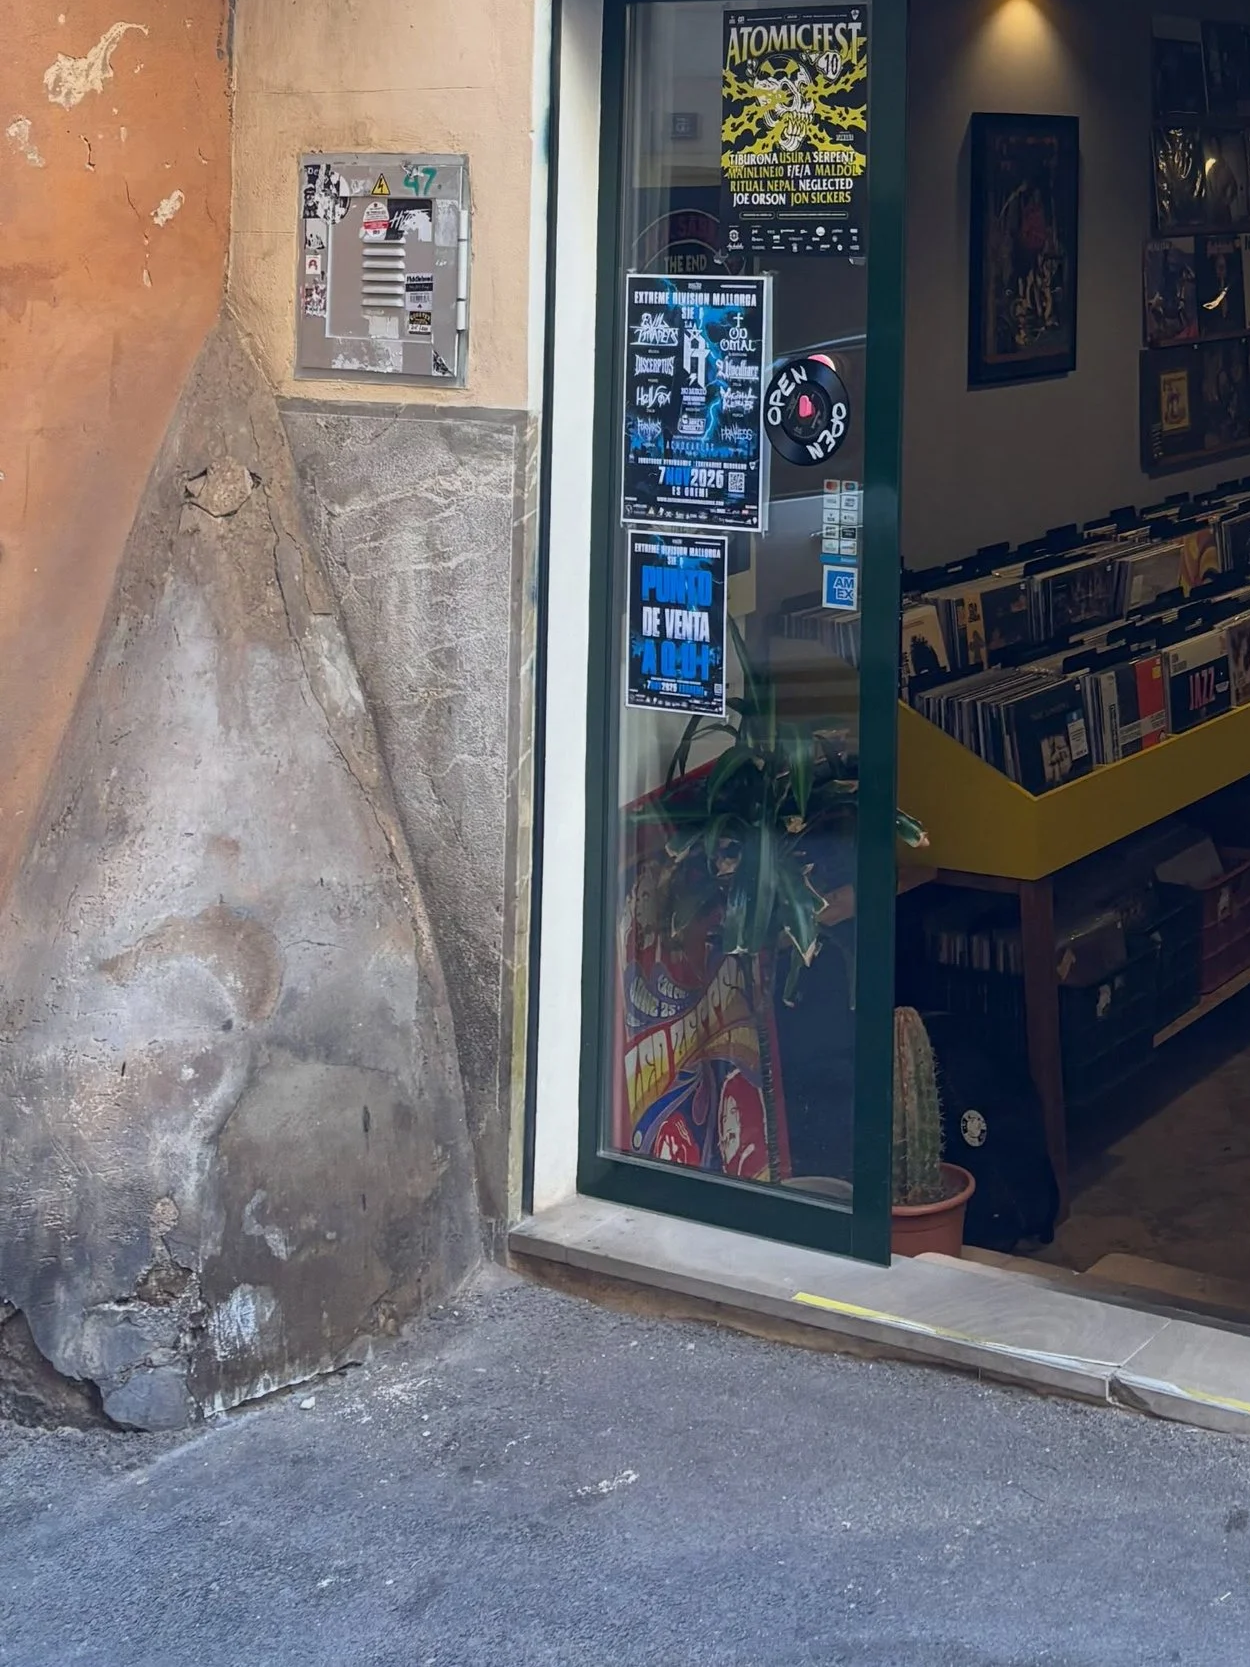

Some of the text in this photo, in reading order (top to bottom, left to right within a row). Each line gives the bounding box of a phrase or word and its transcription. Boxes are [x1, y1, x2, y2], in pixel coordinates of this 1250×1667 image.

[726, 22, 862, 71] ATOMICFEST
[779, 152, 811, 165] USURA
[812, 150, 855, 164] SERPENT
[730, 178, 853, 193] RITUAL NEPAL NEGLECTED
[733, 191, 851, 206] JOE ORSON JON SICKERS
[768, 365, 808, 426] OPEN
[807, 402, 847, 461] OPEN
[641, 565, 713, 607] PUNTO
[833, 577, 855, 589] AM
[836, 588, 855, 602] EX
[642, 606, 710, 643] DE VENTA
